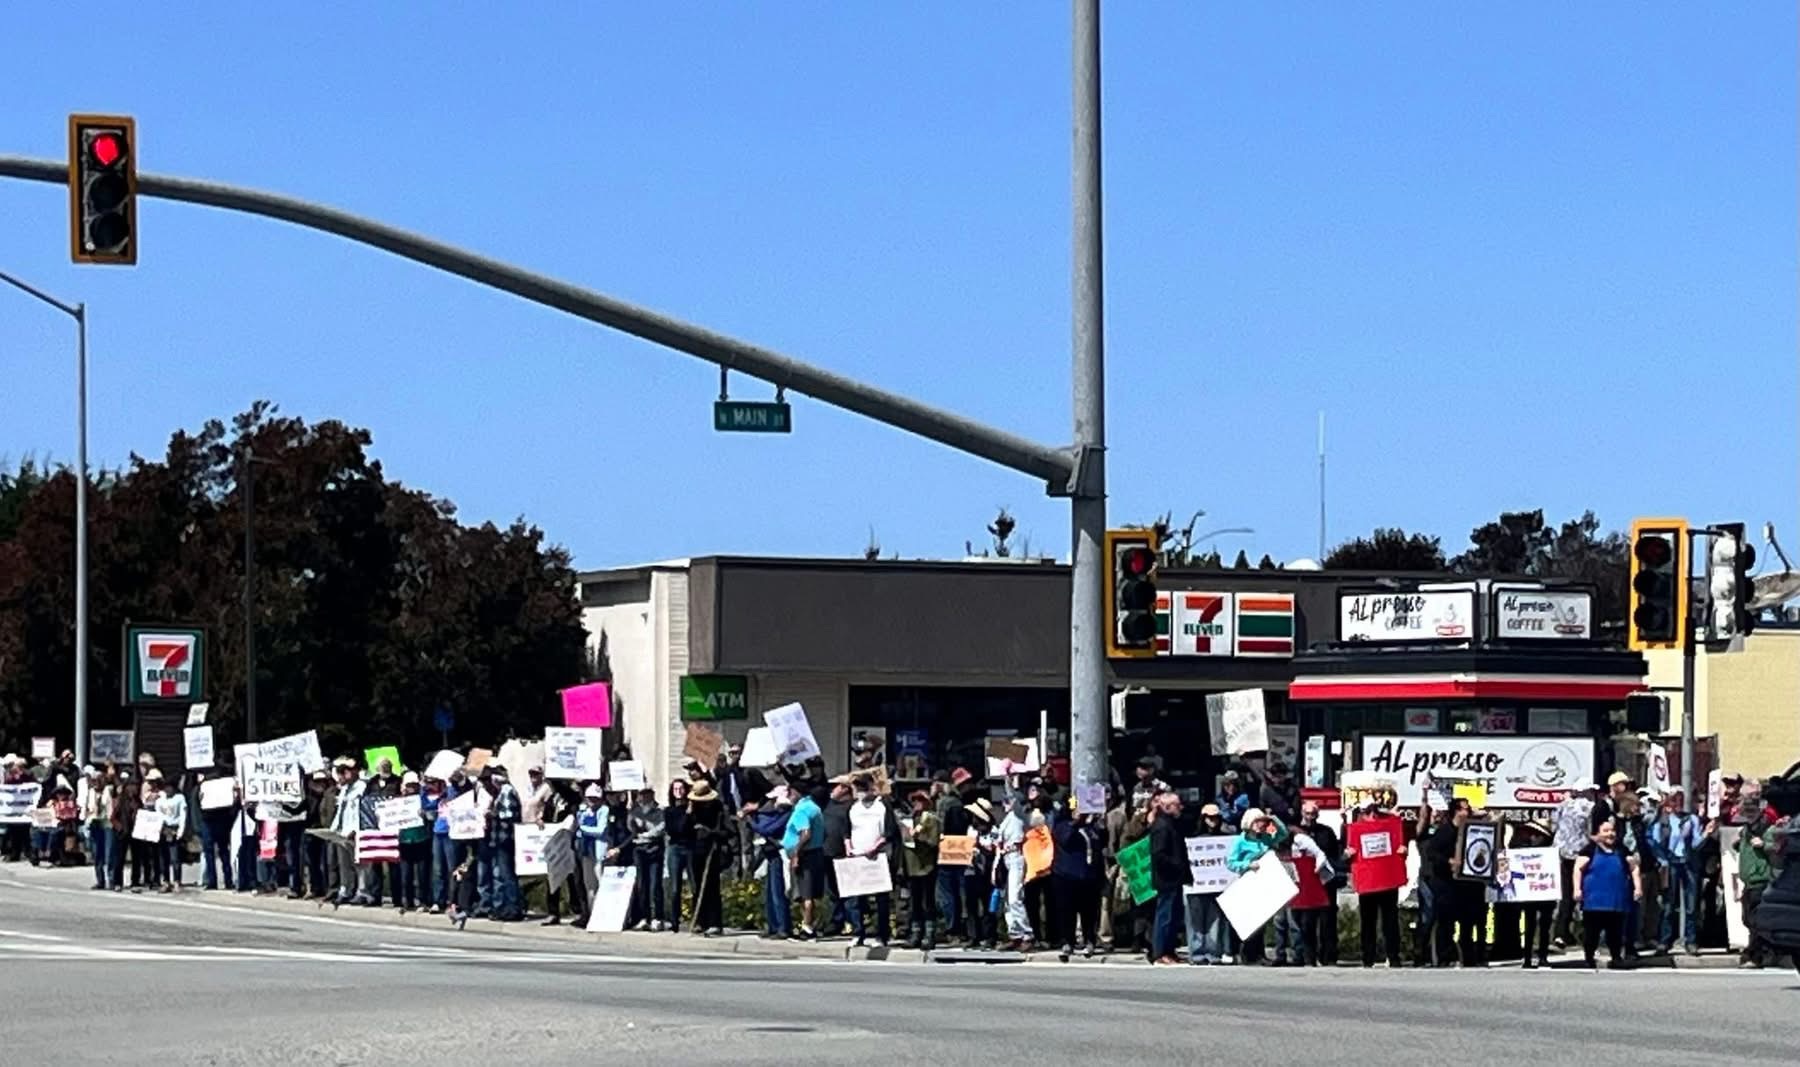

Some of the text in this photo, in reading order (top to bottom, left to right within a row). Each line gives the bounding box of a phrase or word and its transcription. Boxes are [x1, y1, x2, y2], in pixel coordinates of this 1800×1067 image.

[732, 408, 768, 425] MAIN
[1186, 596, 1223, 653] 7
[149, 643, 189, 697] 7
[703, 692, 745, 708] ATM
[254, 761, 293, 776] MUSK
